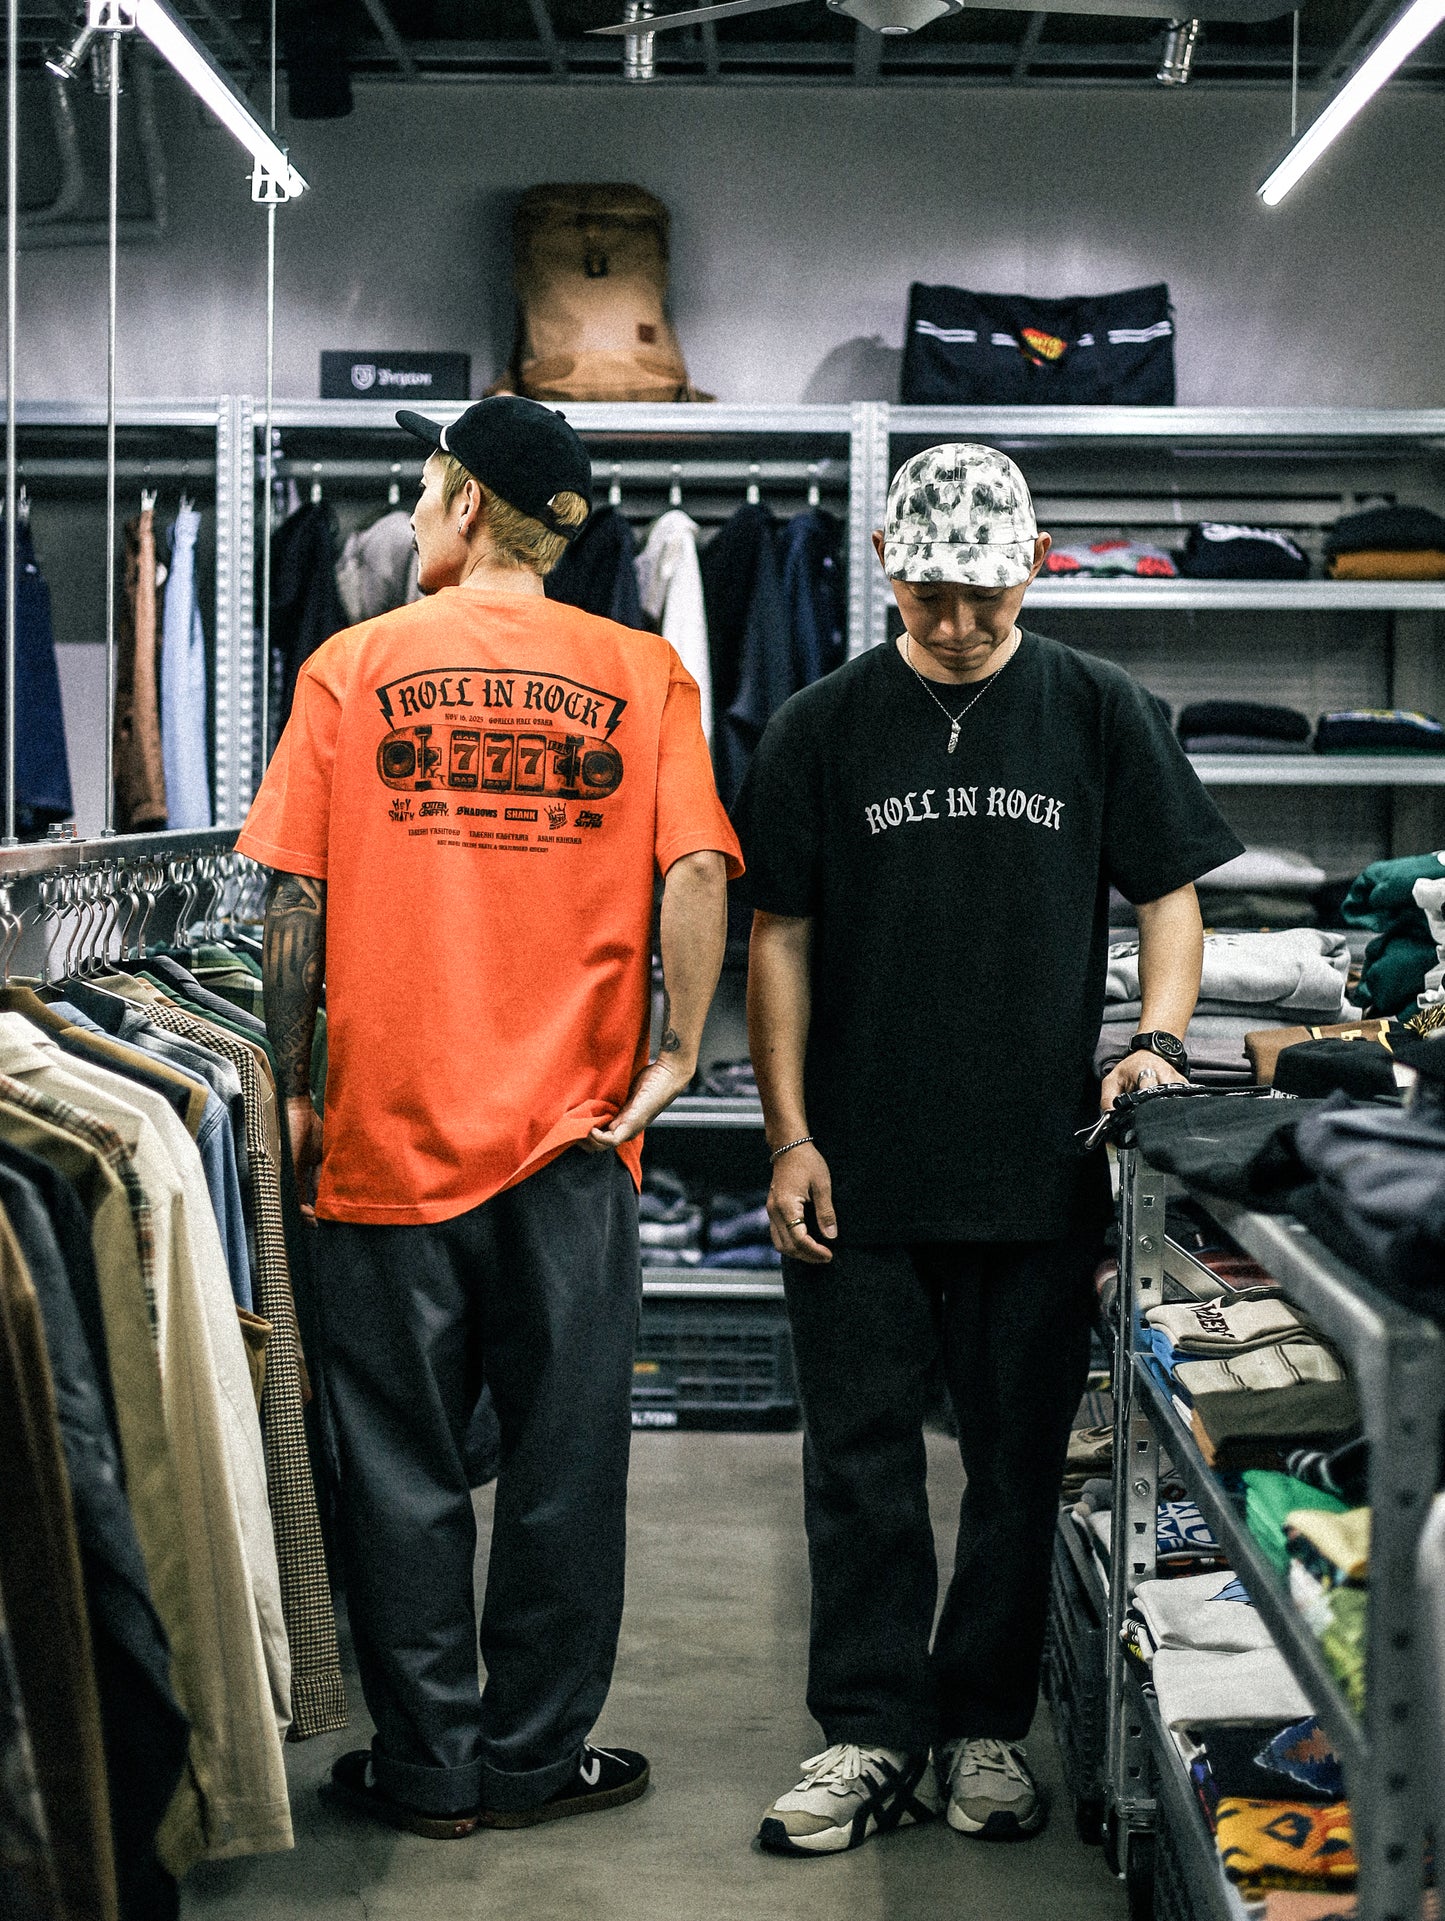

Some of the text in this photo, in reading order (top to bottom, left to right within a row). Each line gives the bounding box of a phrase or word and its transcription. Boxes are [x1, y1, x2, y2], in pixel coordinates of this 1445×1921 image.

[398, 677, 605, 729] ROLL IN ROCK
[444, 713, 458, 721] NOV
[468, 715, 484, 723] 2025
[453, 743, 544, 774] 7 7 7
[506, 809, 537, 820] SHANK
[864, 786, 1066, 835] ROLL IN ROCK
